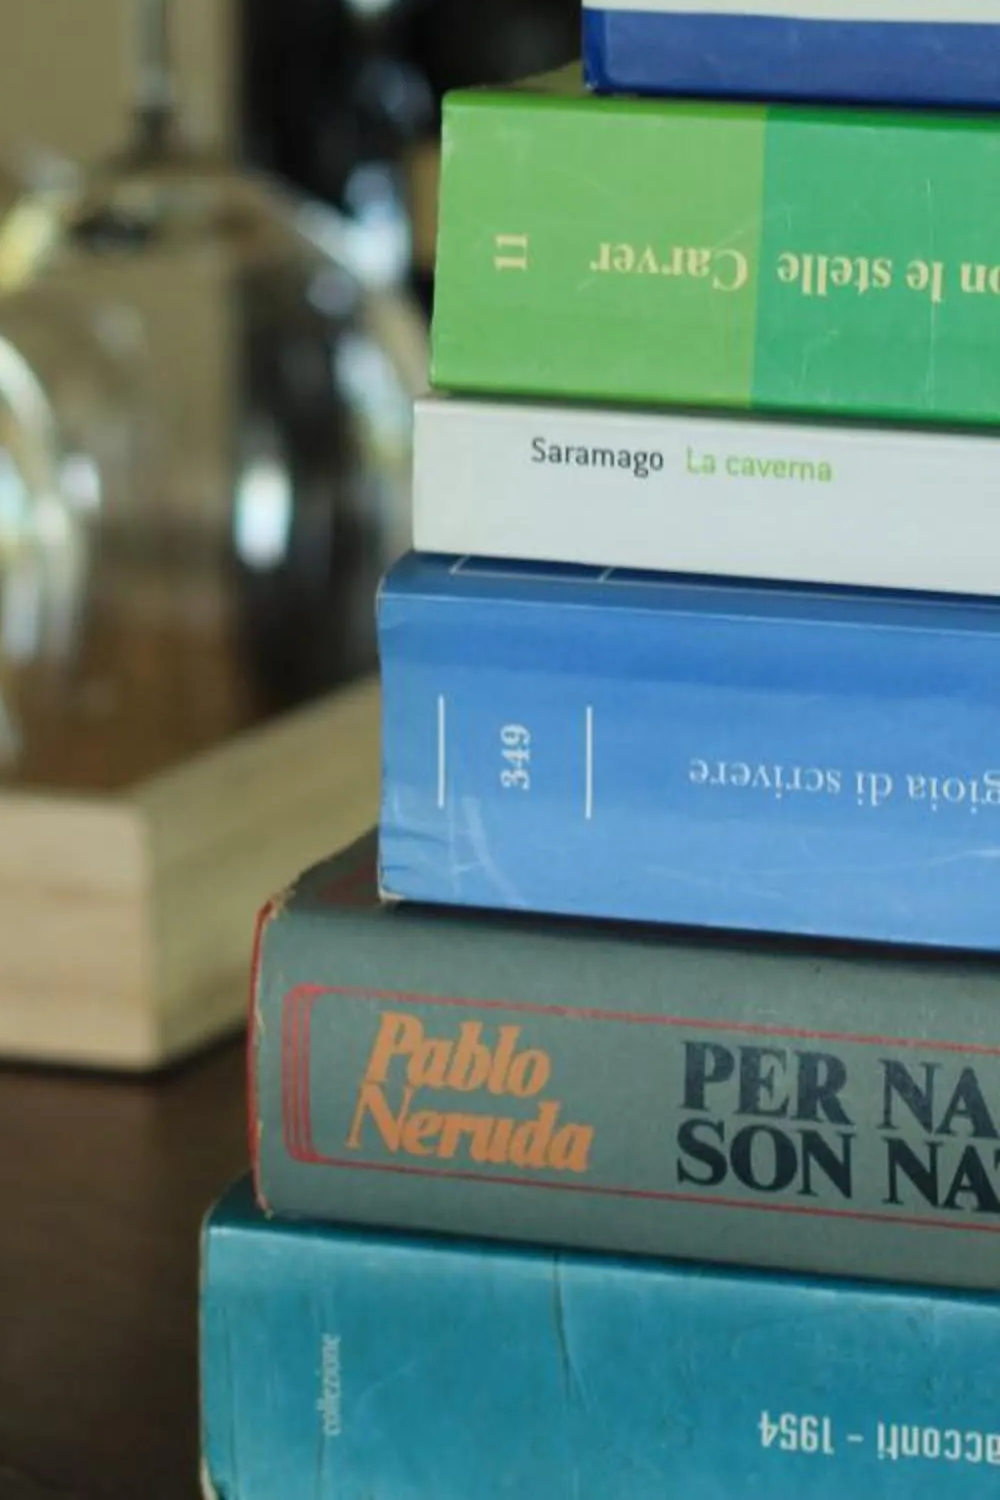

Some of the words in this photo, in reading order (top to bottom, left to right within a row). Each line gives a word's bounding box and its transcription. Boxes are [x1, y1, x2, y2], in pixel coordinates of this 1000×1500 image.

[588, 241, 749, 292] Carver
[777, 251, 892, 296] stelle
[906, 259, 943, 302] le
[531, 436, 665, 479] Saramago
[685, 445, 716, 475] La
[725, 455, 833, 483] caverna
[499, 723, 531, 791] 349
[688, 757, 842, 799] scrivere
[855, 769, 893, 807] di
[905, 769, 1000, 815] gioia
[365, 1010, 551, 1097] Pablo
[681, 1040, 856, 1127] PER
[876, 1057, 1000, 1140] NA
[345, 1080, 595, 1172] Neruda
[677, 1118, 854, 1201] SON
[881, 1134, 1000, 1215] NA
[757, 1409, 835, 1456] 1954
[877, 1421, 1000, 1465] acconti
